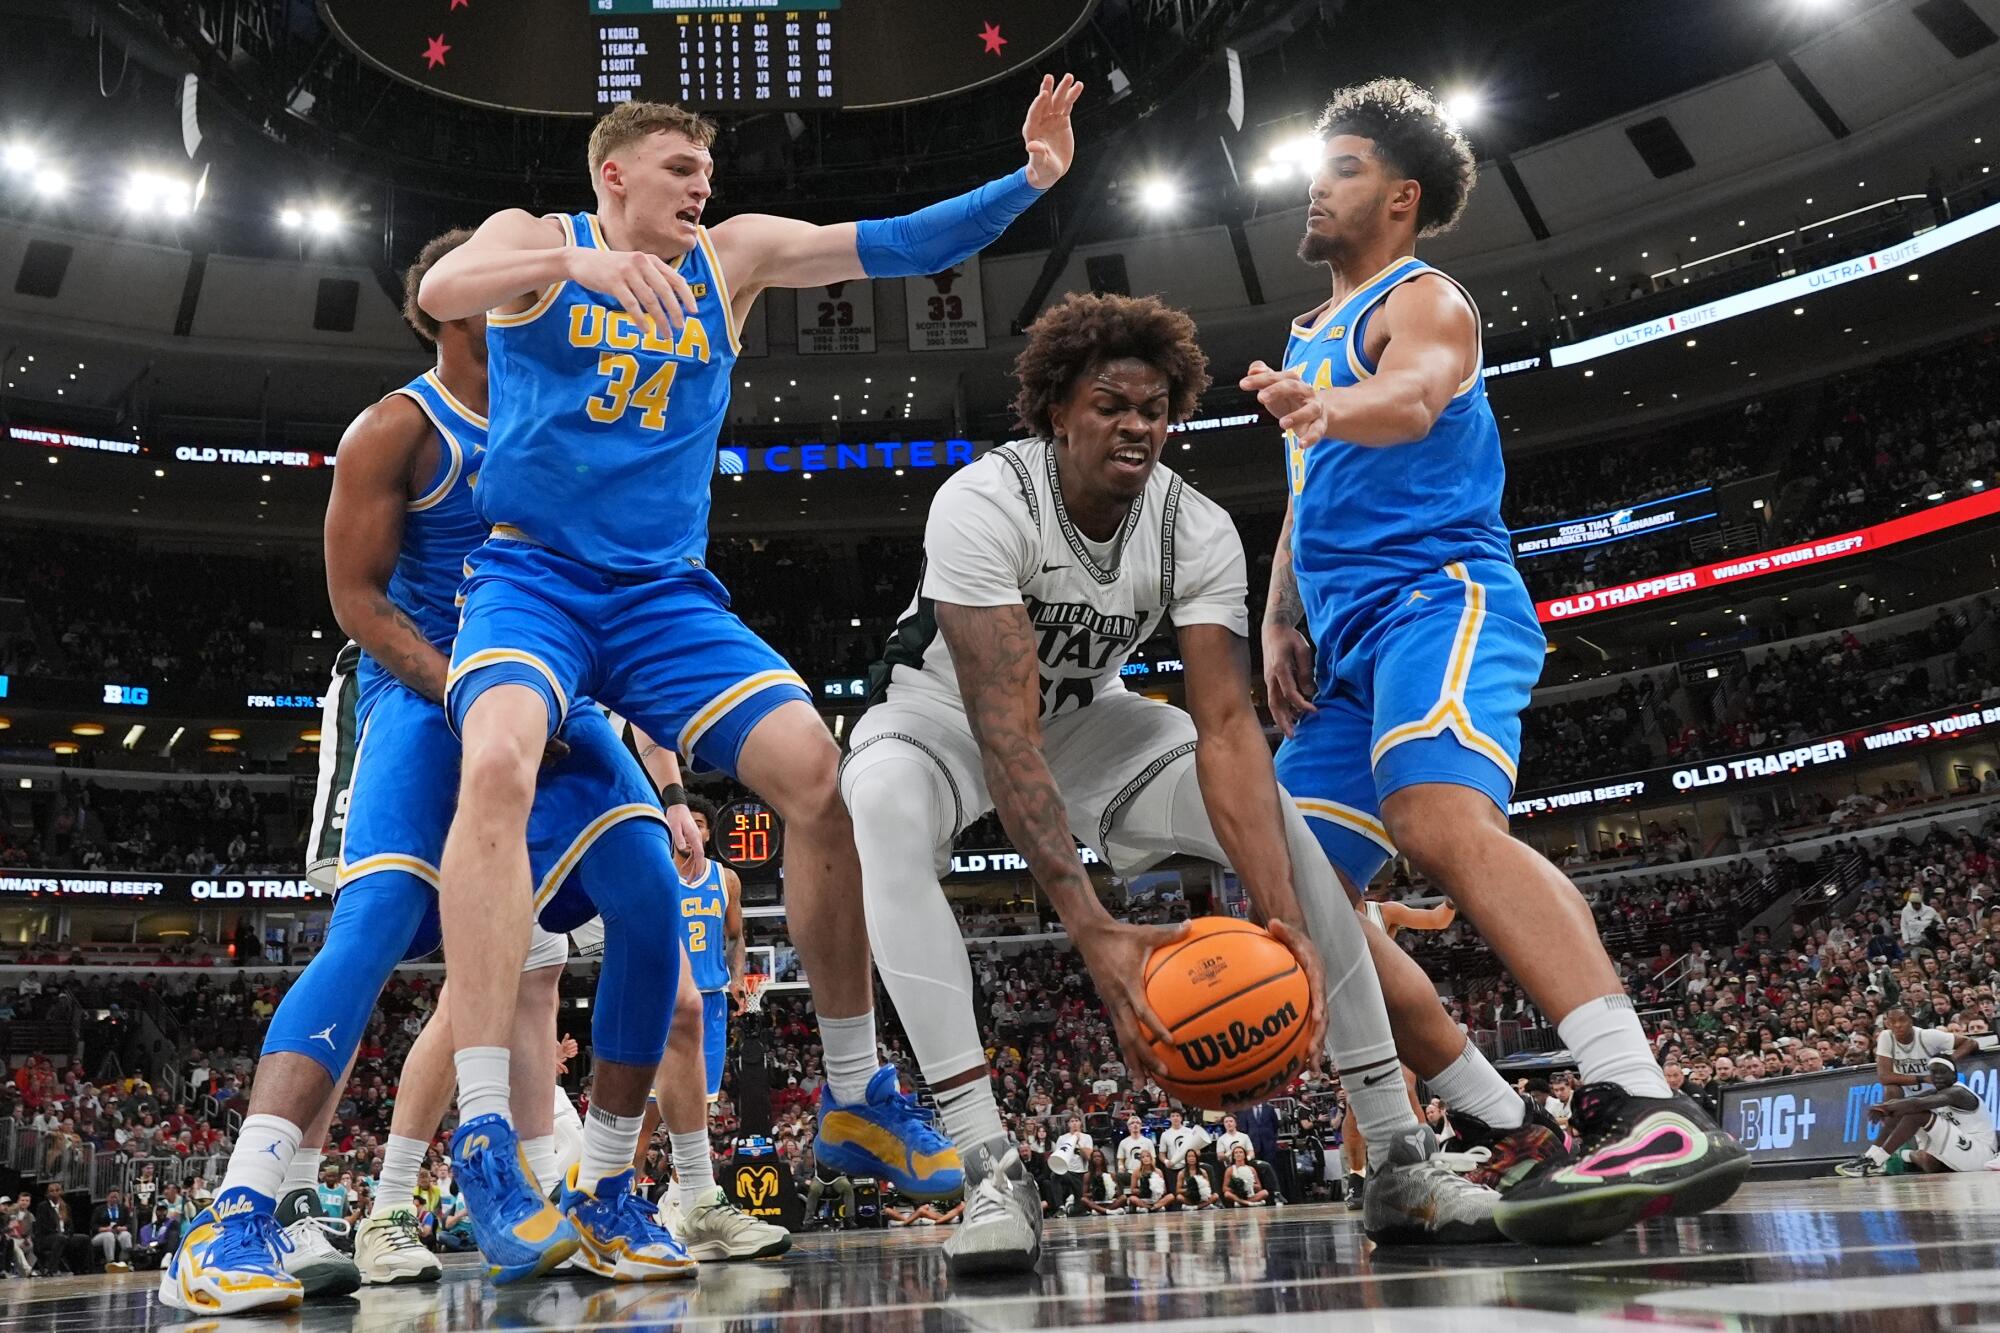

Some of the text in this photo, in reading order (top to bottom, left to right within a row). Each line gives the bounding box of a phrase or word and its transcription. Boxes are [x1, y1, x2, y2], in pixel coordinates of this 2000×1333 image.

[608, 27, 639, 40] KOHLER
[680, 26, 686, 38] 7
[698, 25, 703, 37] 1
[715, 25, 721, 37] 0
[732, 25, 738, 37] 2
[786, 23, 800, 36] 0/2
[816, 23, 831, 35] 0/0
[602, 44, 607, 56] 1
[608, 43, 633, 56] FEARS
[679, 42, 688, 54] 11
[698, 42, 704, 53] 0
[715, 41, 721, 53] 5
[754, 40, 768, 52] 2/2
[788, 39, 799, 51] 1/1
[817, 38, 831, 50] 0/0
[609, 58, 635, 71] SCOTT
[698, 57, 705, 69] 0
[716, 56, 722, 68] 4
[757, 55, 768, 68] 1/2
[788, 54, 800, 67] 1/2
[819, 54, 829, 66] 1/1
[598, 75, 608, 87] 15
[609, 74, 641, 87] COOPER
[680, 73, 690, 85] 10
[700, 72, 704, 84] 1
[716, 72, 722, 84] 2
[733, 72, 739, 84] 2
[757, 71, 769, 83] 1/3
[818, 70, 832, 82] 0/0
[610, 90, 631, 102] CARR
[700, 88, 705, 100] 1
[717, 88, 723, 100] 5
[734, 87, 740, 99] 2
[756, 86, 770, 99] 2/5
[789, 86, 800, 98] 1/1
[818, 85, 832, 97] 0/0
[1808, 243, 1920, 287] ULTRA SUITE
[818, 301, 853, 327] 23
[927, 295, 963, 321] 33
[568, 304, 711, 364] UCLA
[1614, 307, 1718, 347] ULTRA SUITE
[1500, 357, 1540, 374] BEEF?
[586, 352, 678, 432] 34
[1186, 418, 1220, 431] YOUR
[1221, 414, 1258, 427] BEEF?
[9, 428, 139, 454] WHAT'S YOUR BEEF?
[175, 446, 218, 461] OLD
[218, 448, 309, 466] TRAPPER
[763, 439, 975, 472] CENTER
[1518, 538, 1549, 552] MEN'S
[1550, 530, 1611, 547] BASKETBALL
[1611, 511, 1675, 535] TOURNAMENT
[1712, 536, 1864, 580] WHAT'S YOUR BEEF?
[1549, 572, 1696, 618] OLD TRAPPER
[1040, 604, 1133, 636] MICHIGAN
[1121, 660, 1183, 676] 50% FT%
[247, 695, 275, 707] FG%
[1864, 724, 1930, 749] WHAT'S
[1930, 712, 1981, 735] YOUR
[1672, 739, 1846, 790] OLD TRAPPER
[1547, 790, 1592, 808] YOUR
[1594, 781, 1644, 801] BEEF?
[735, 813, 770, 830] 9:17
[728, 831, 768, 861] 30
[950, 855, 987, 872] LD
[0, 878, 164, 896] WHAT'S YOUR BEEF?
[191, 880, 322, 898] OLD TRAP
[680, 897, 722, 919] CLA
[688, 920, 706, 953] 2
[1177, 1001, 1299, 1072] Wilson
